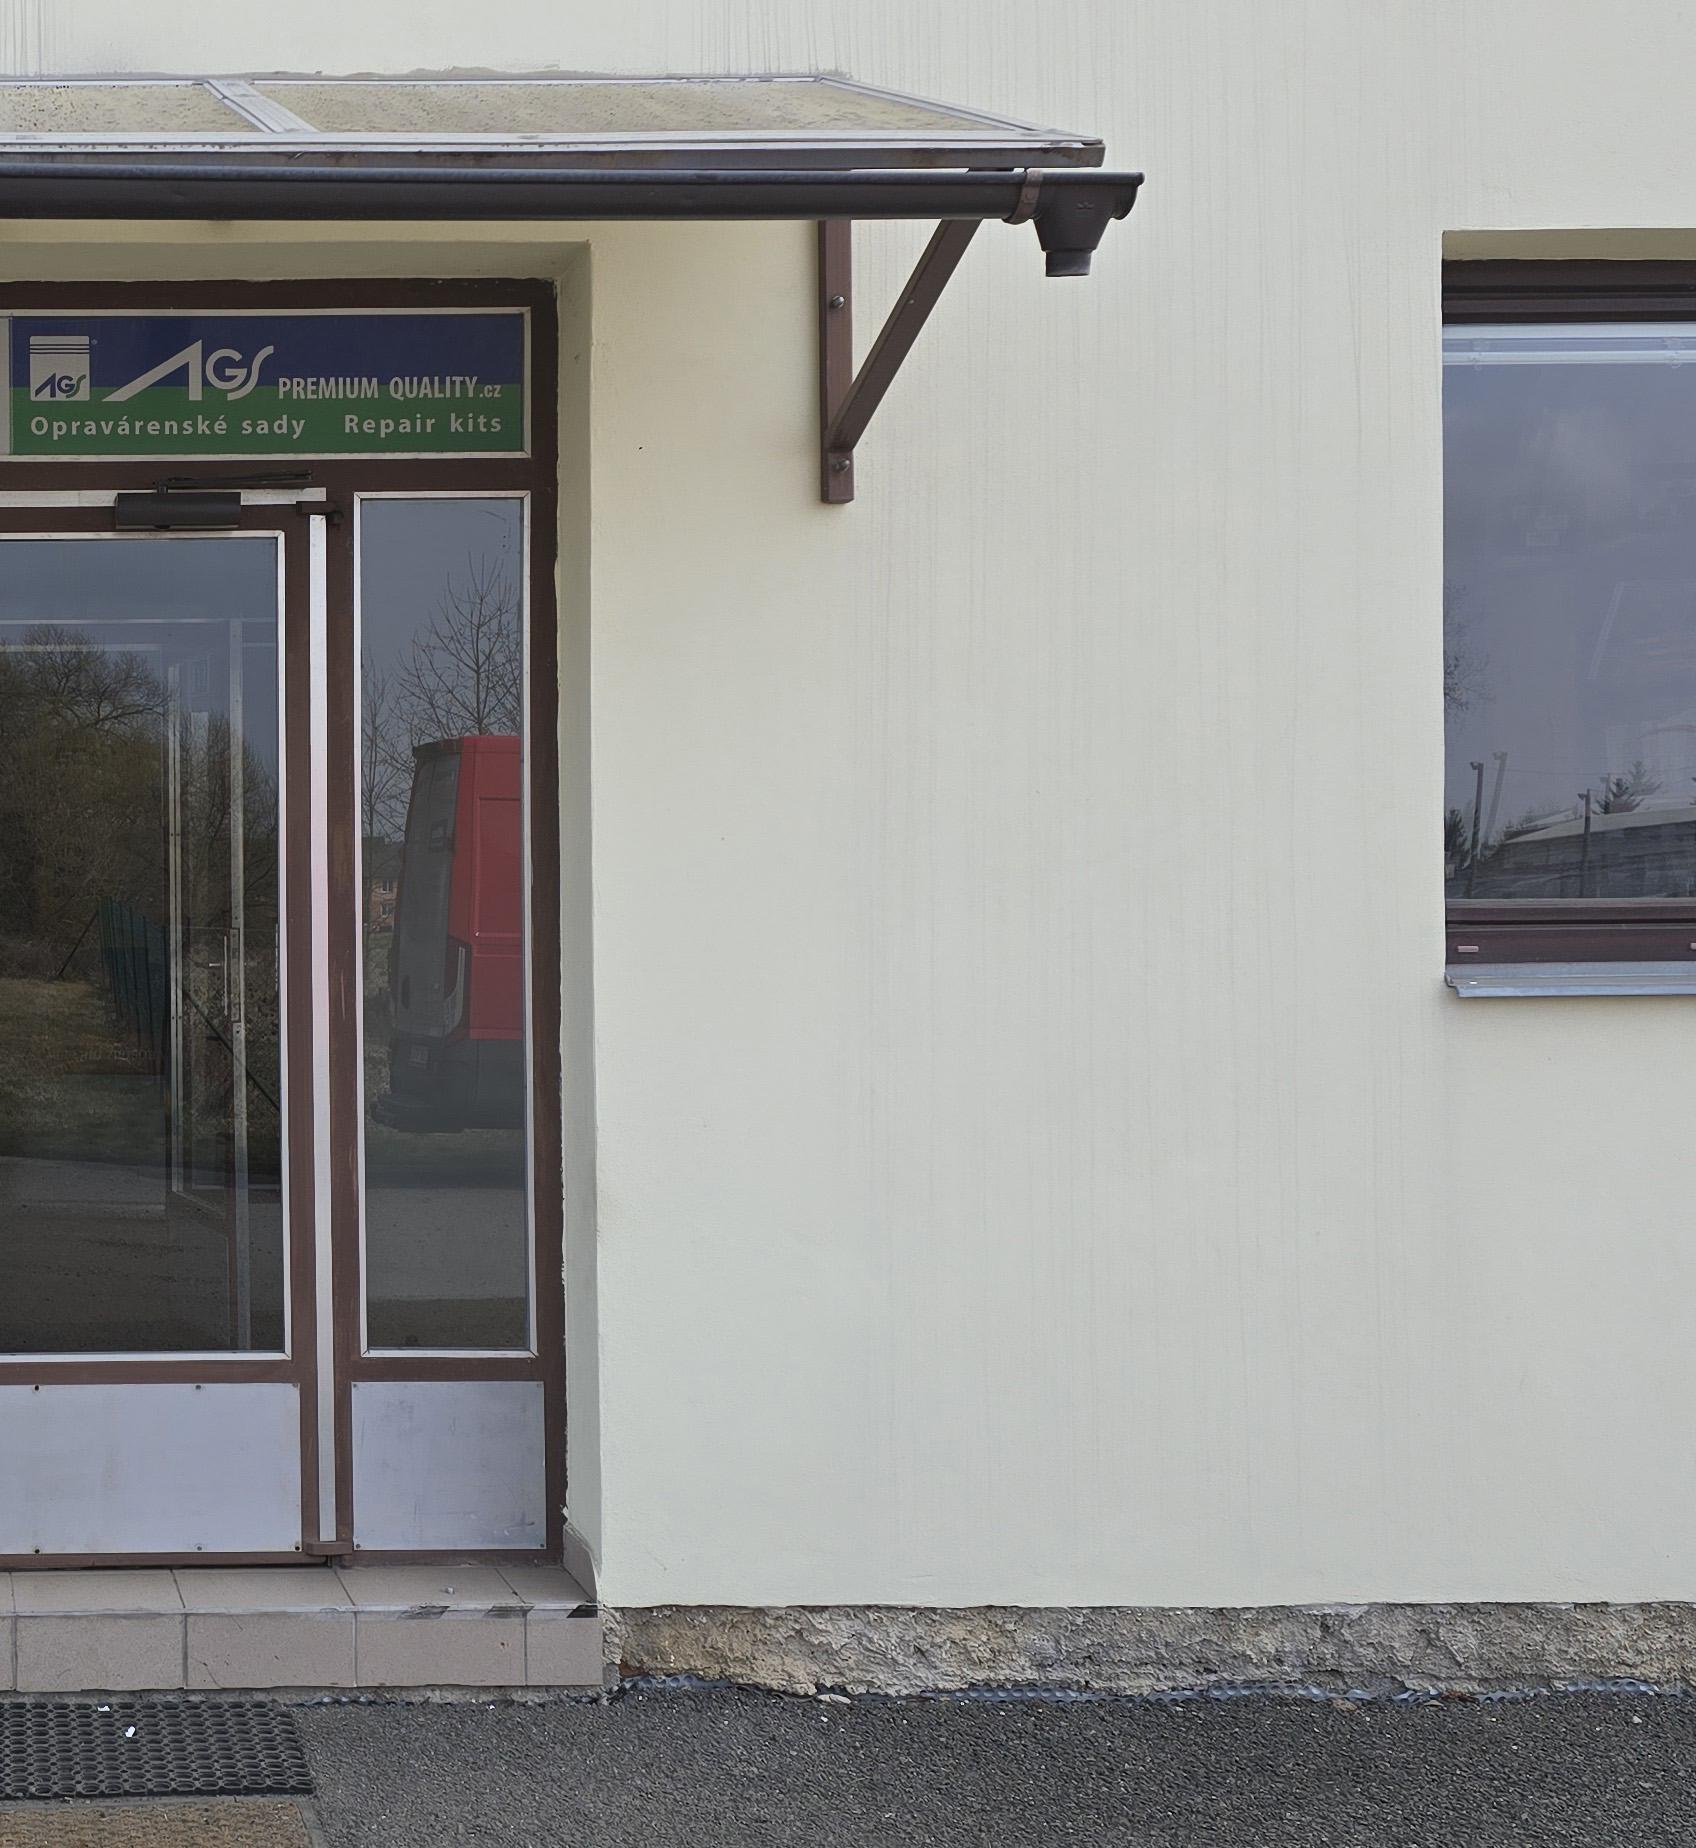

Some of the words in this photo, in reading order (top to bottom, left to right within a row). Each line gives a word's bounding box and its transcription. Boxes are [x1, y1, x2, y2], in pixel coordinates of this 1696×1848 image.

[102, 339, 274, 401] AGS
[34, 372, 87, 399] AGS
[278, 377, 379, 400] PREMIUM
[389, 376, 502, 400] QUALITY.cz
[30, 415, 228, 440] Opravárenské
[241, 414, 306, 439] sady
[344, 413, 436, 438] Repair
[450, 413, 502, 433] kits
